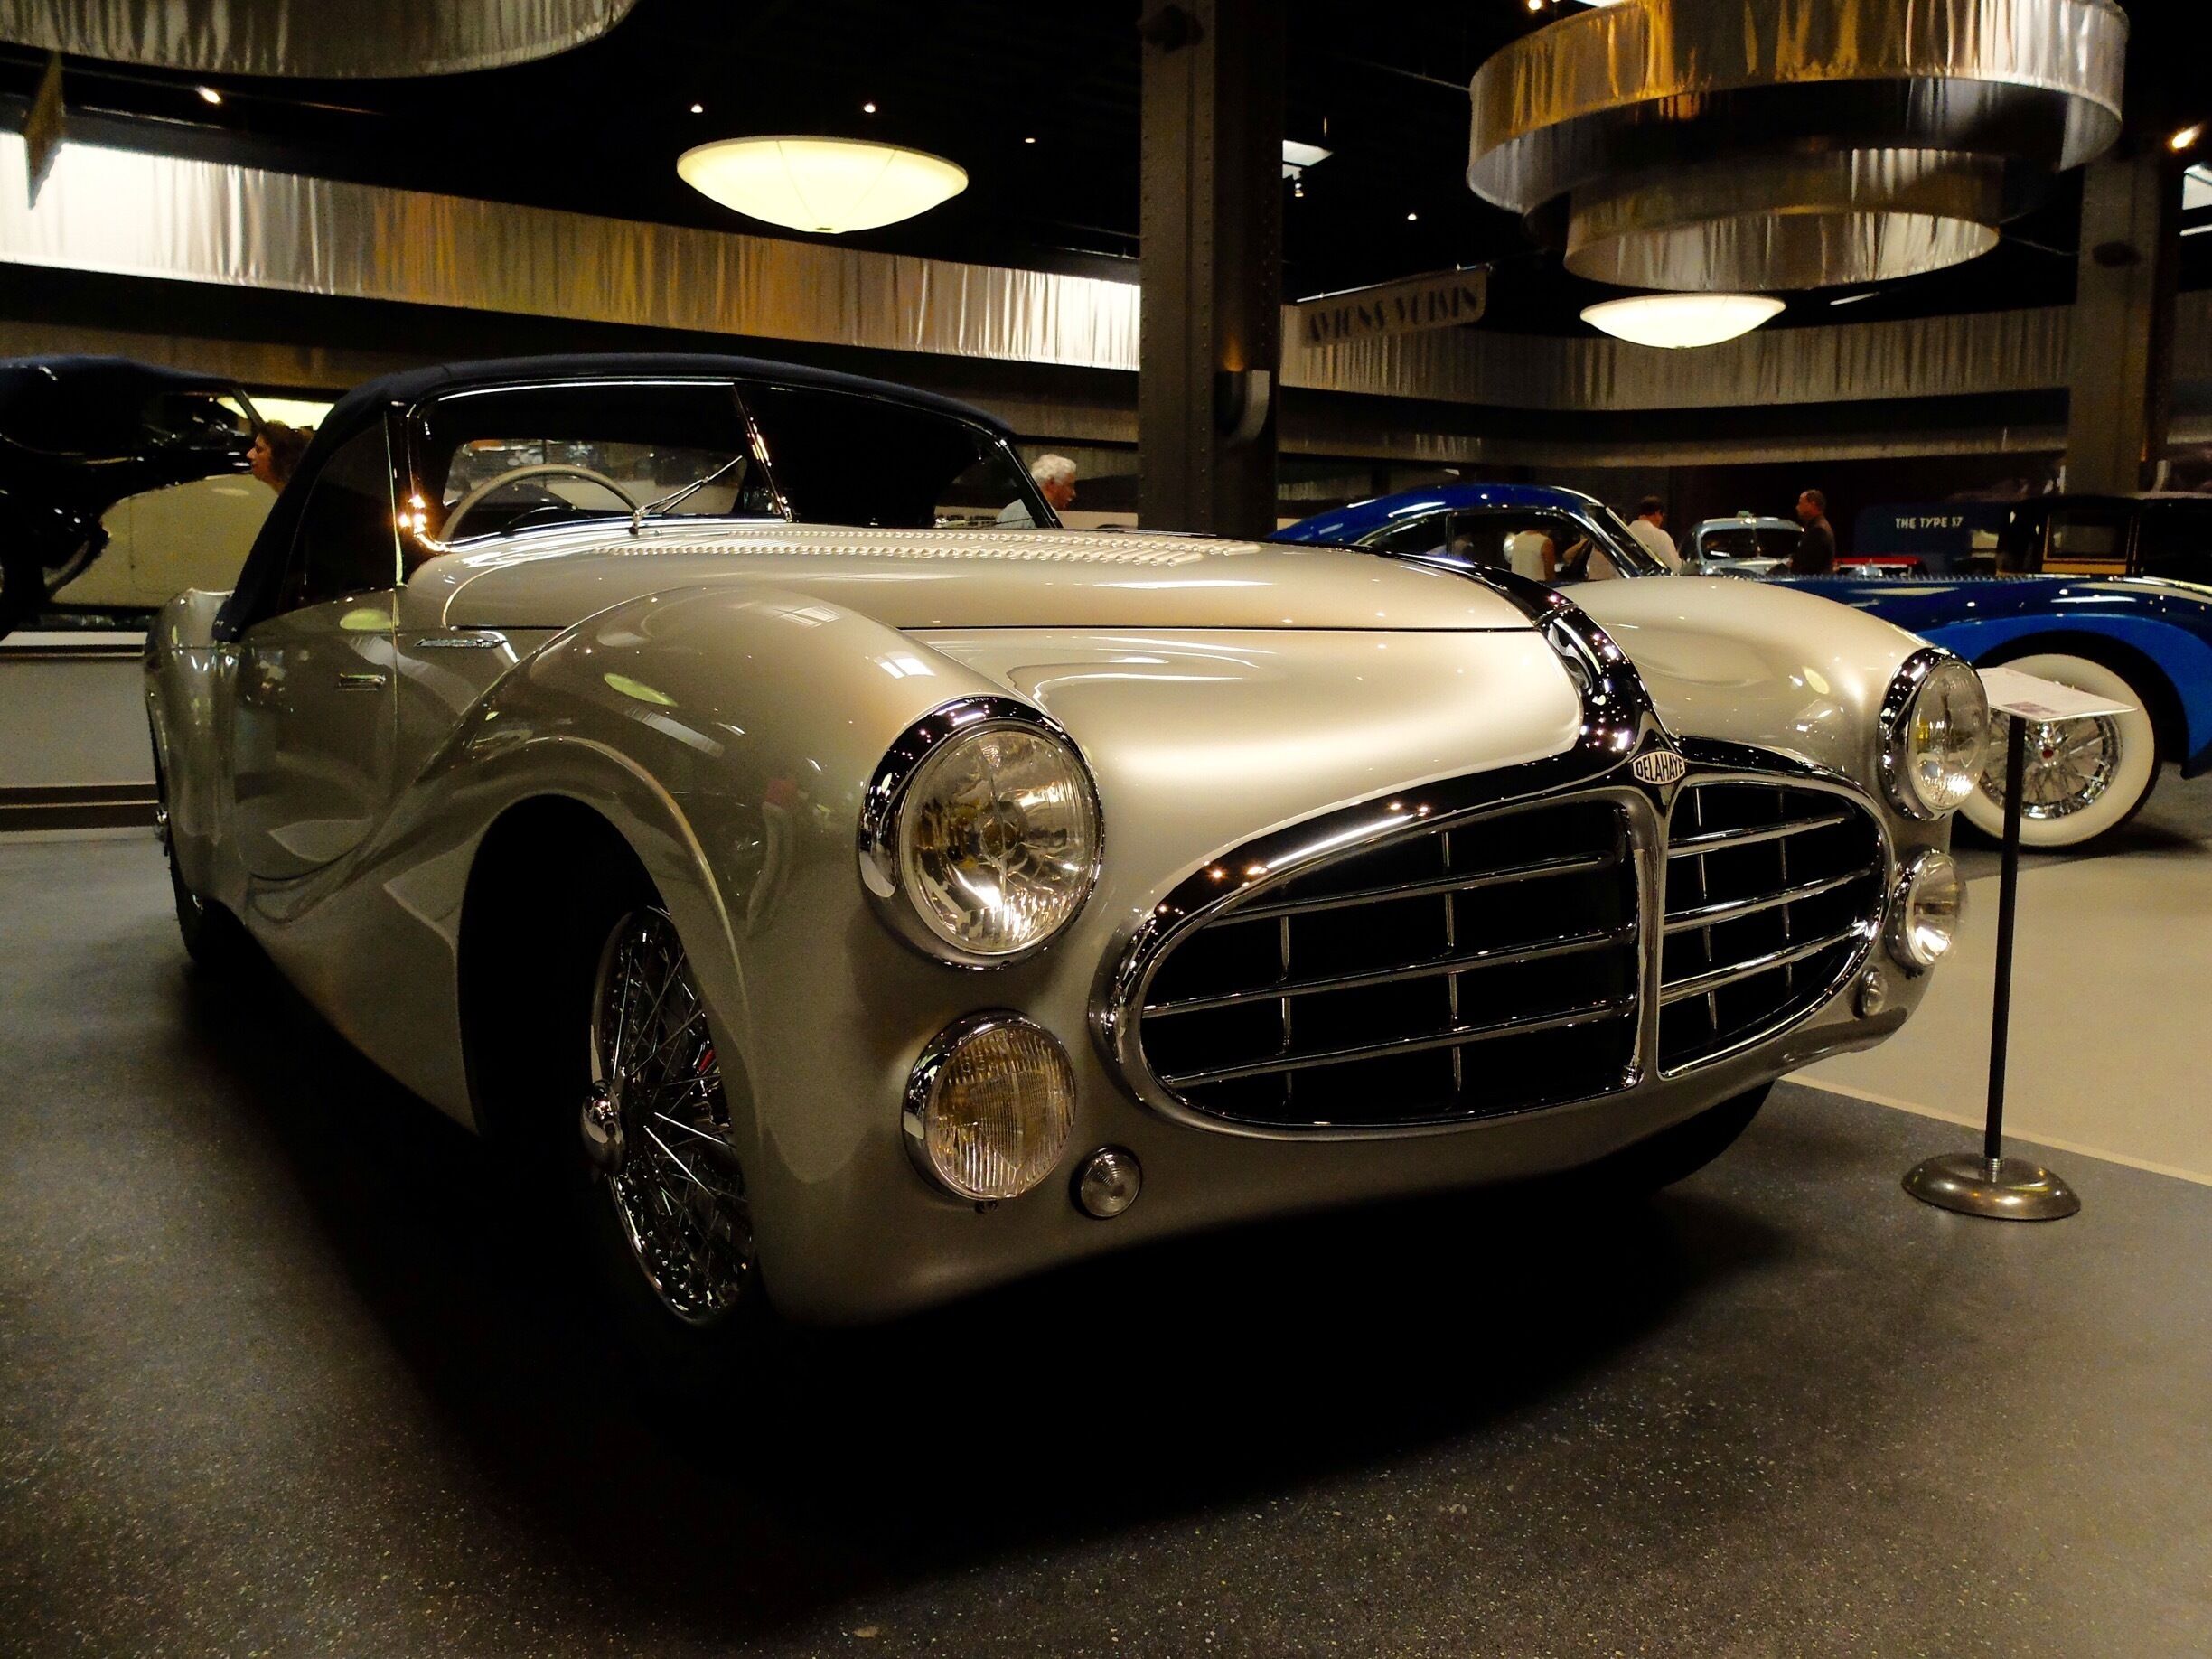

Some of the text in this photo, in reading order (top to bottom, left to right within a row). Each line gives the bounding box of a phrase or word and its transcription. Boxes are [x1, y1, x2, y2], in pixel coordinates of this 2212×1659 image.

[1895, 517, 1917, 529] THE
[1920, 516, 1948, 529] TYPE
[1635, 753, 1684, 782] DELAHAYE
